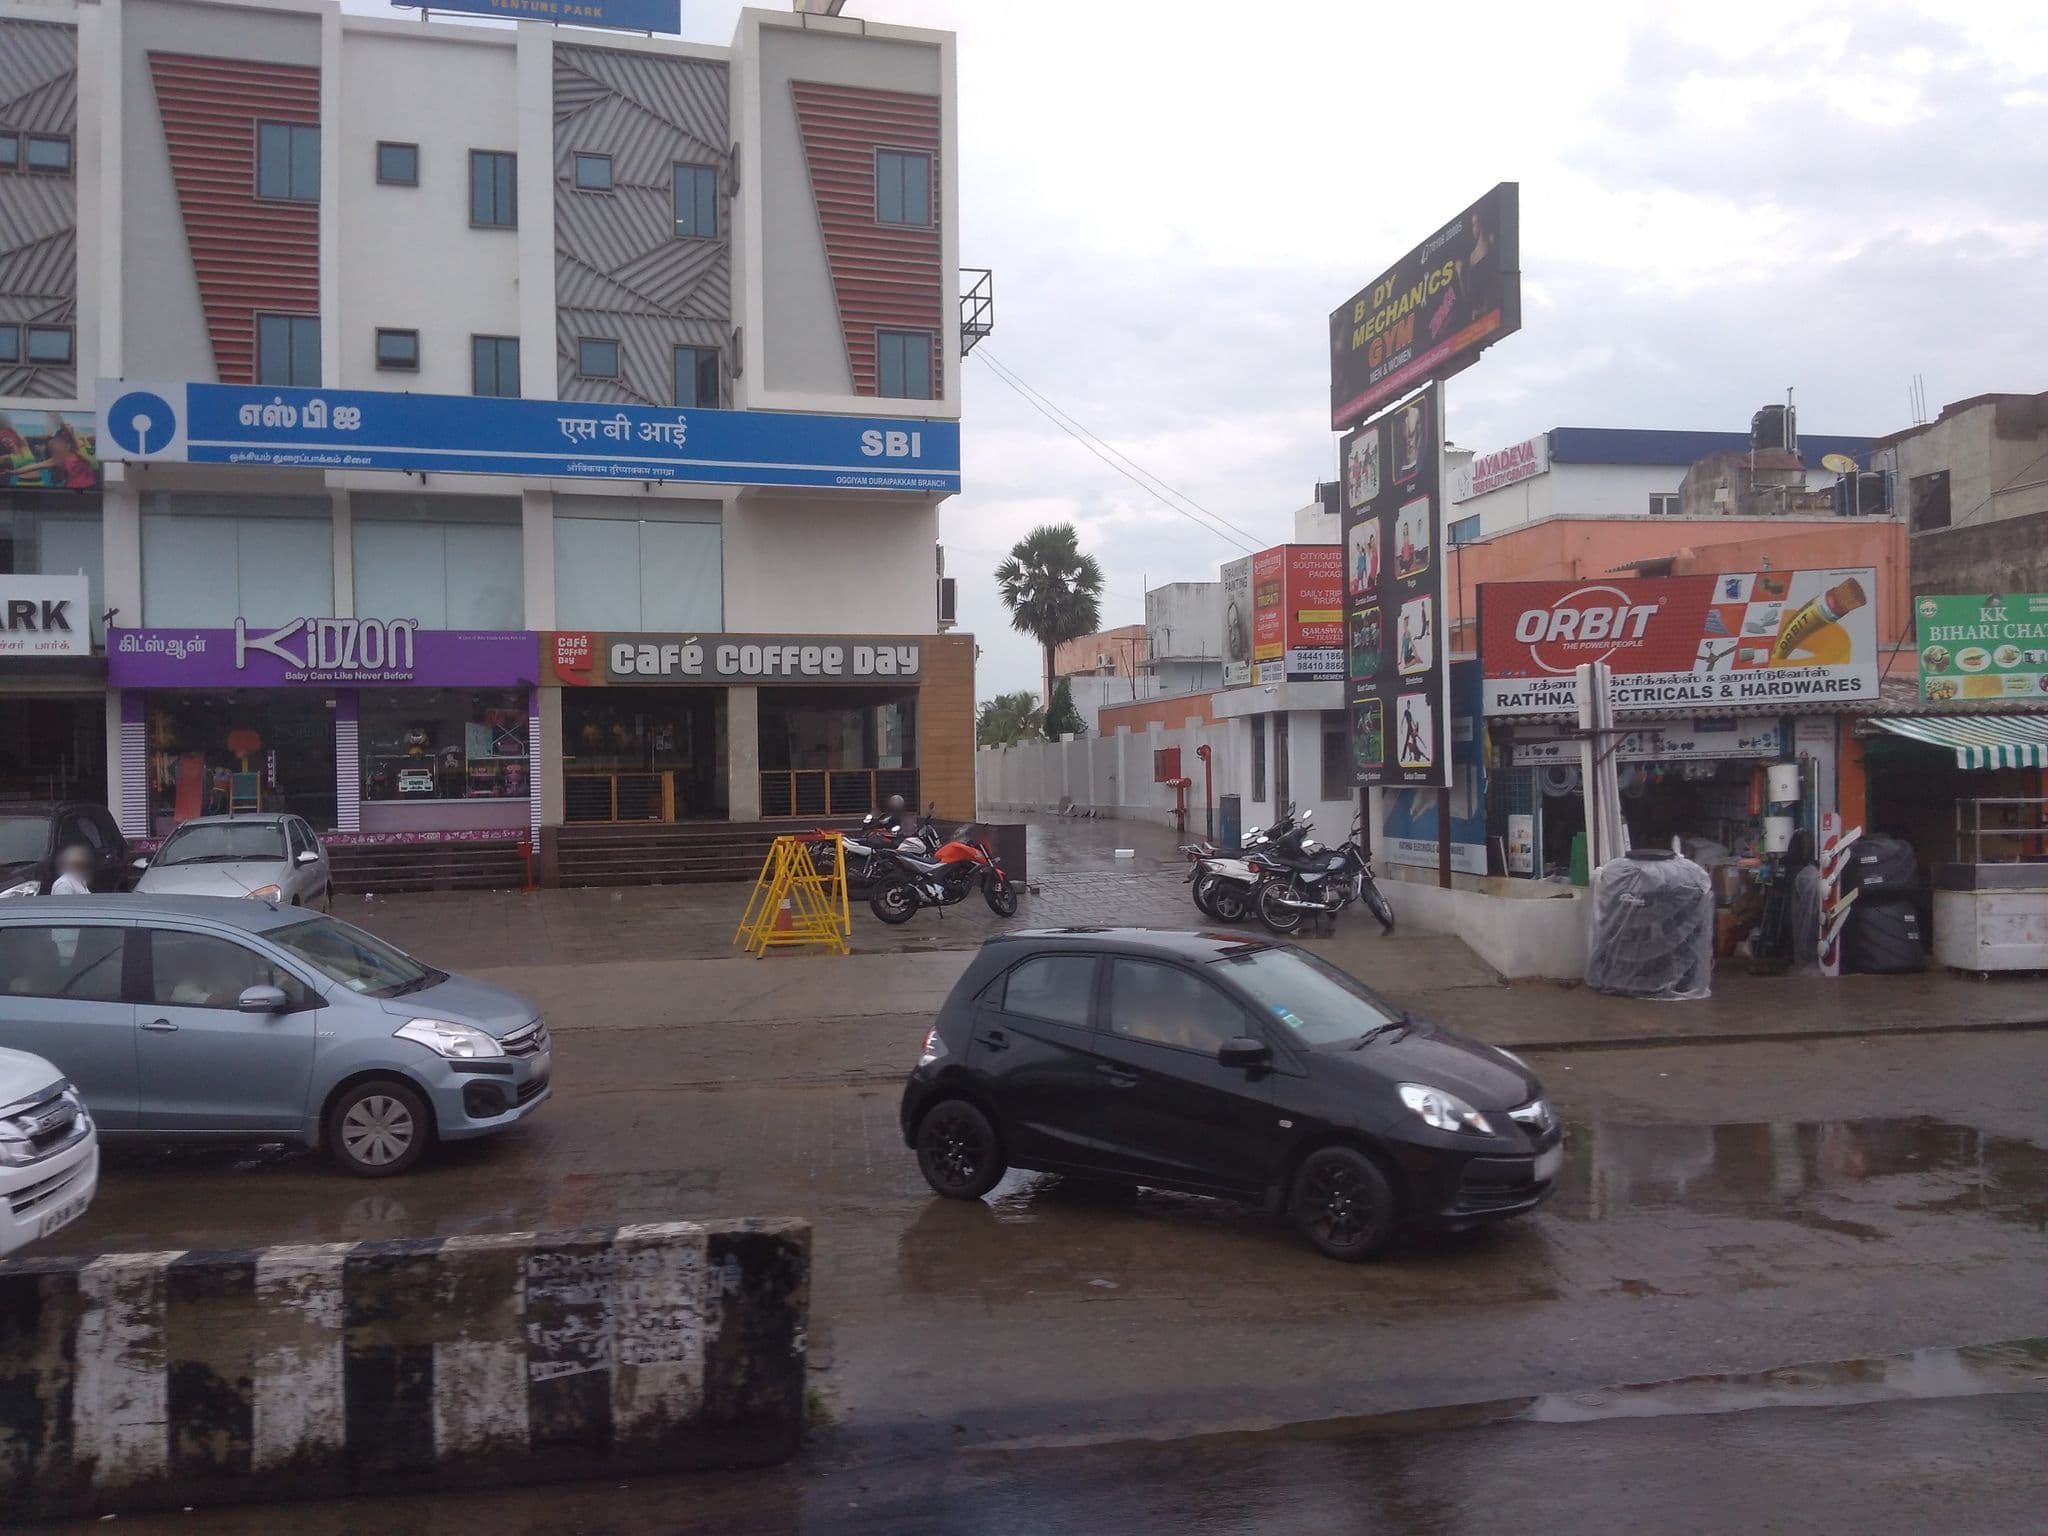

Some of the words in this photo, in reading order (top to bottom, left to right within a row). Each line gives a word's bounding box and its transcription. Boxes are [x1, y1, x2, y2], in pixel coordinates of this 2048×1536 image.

[491, 0, 558, 13] VENTURE
[563, 4, 602, 17] PARK
[1352, 261, 1454, 351] MECHANICS
[1368, 313, 1416, 368] GYM
[557, 418, 598, 444] एस
[600, 413, 632, 440] बी
[637, 415, 688, 449] आई
[861, 430, 921, 458] SBI
[1472, 440, 1535, 480] JAYADEVA
[836, 476, 868, 485] OGGIYAM
[868, 477, 917, 487] DURAIPAKKAM
[918, 479, 946, 487] BRANCH
[1300, 590, 1323, 598] DAILY
[0, 600, 72, 631] RK
[1515, 605, 1660, 643] ORBIT
[1979, 607, 2008, 622] KK
[1779, 613, 1810, 651] ORBIT
[1929, 624, 2000, 641] BIHARI
[1296, 652, 1322, 660] 94441
[1580, 642, 1611, 650] POWER
[1611, 640, 1644, 649] PEOPLE
[853, 646, 919, 676] Day
[1297, 662, 1323, 670] 98410
[285, 672, 308, 682] Baby
[310, 672, 332, 680] Care
[334, 672, 351, 680] Like
[354, 672, 381, 680] Never
[383, 672, 413, 680] Before
[1706, 675, 1715, 683] &
[1497, 691, 1576, 707] RATHNA
[1609, 685, 1713, 703] ECTRICALS
[1720, 685, 1733, 698] &
[1740, 678, 1862, 697] HARDWARES
